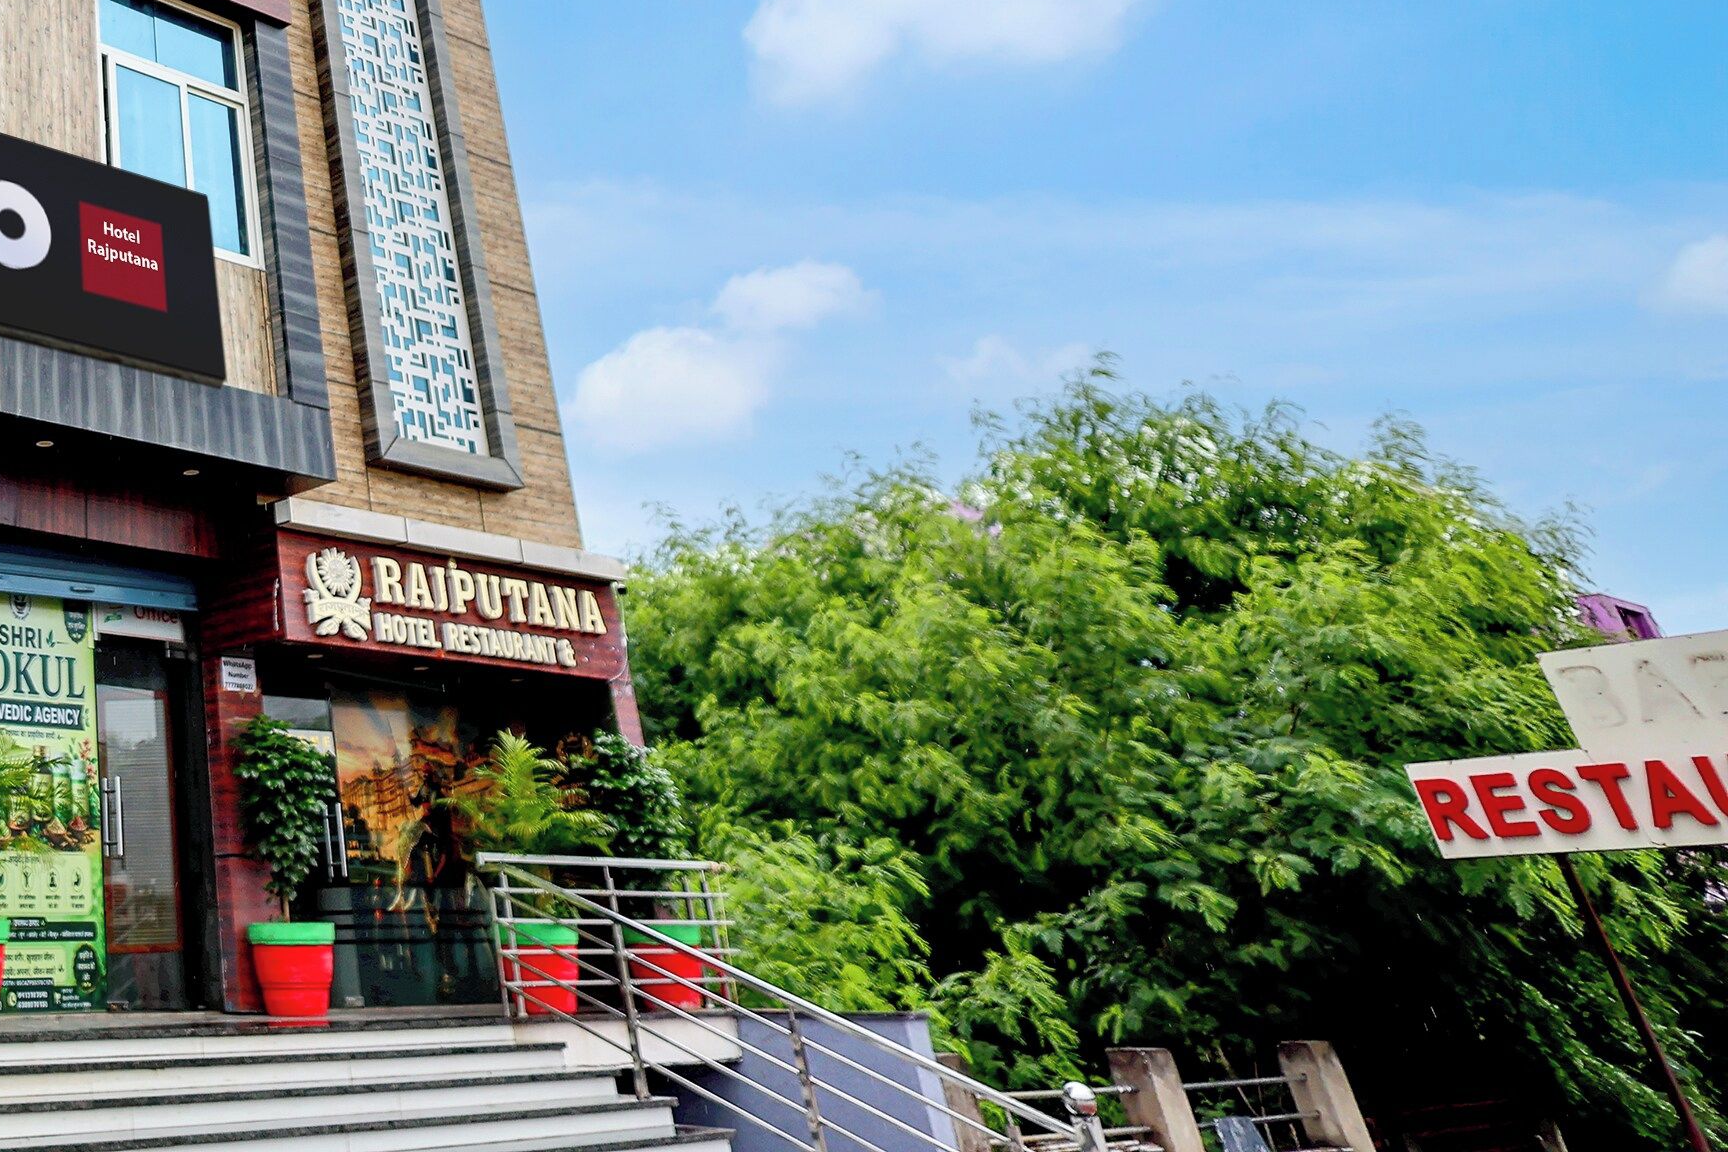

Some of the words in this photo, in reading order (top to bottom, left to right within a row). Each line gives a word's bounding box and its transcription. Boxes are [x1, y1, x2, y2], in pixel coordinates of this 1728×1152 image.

[103, 221, 140, 244] Hotel
[87, 238, 159, 271] Rajputana
[374, 612, 442, 647] HOTEL
[443, 622, 557, 665] RESTAURANT
[34, 706, 80, 726] AGENCY
